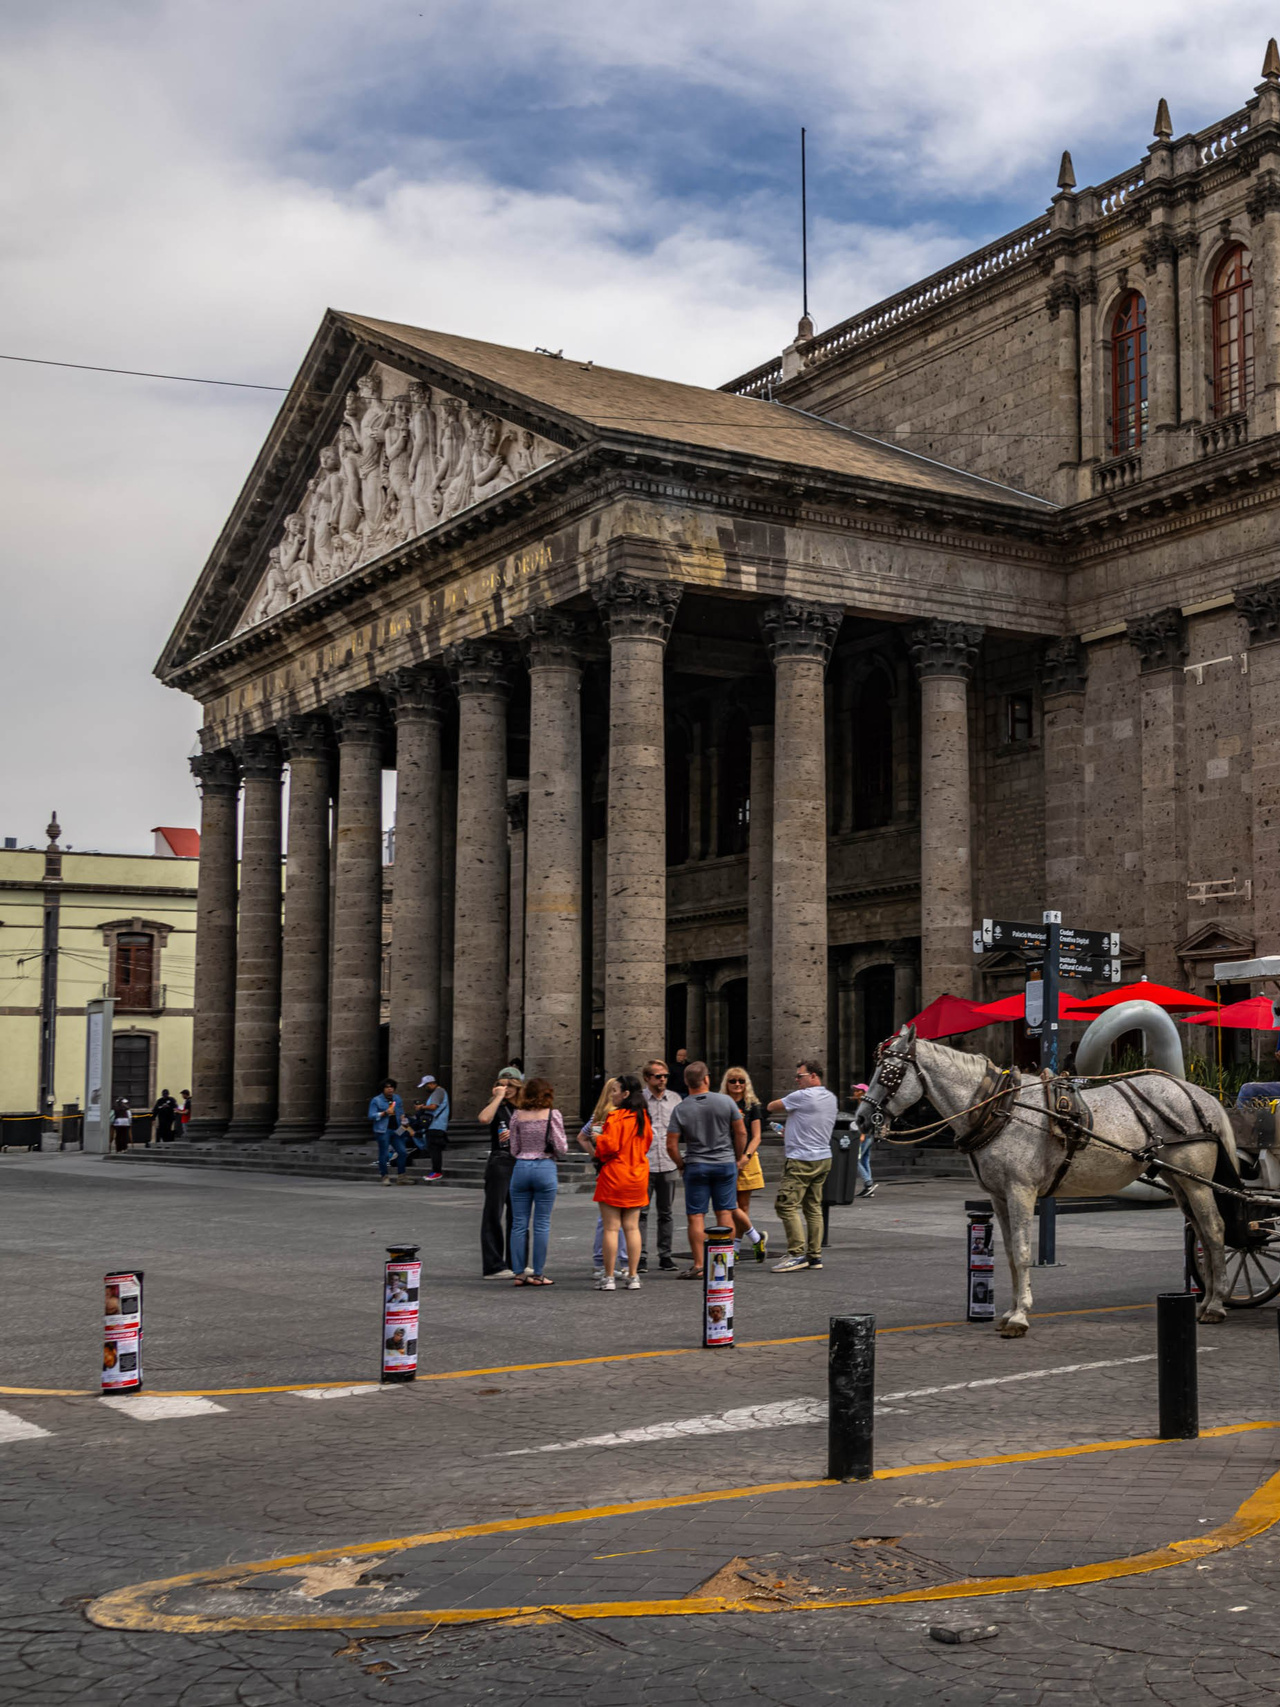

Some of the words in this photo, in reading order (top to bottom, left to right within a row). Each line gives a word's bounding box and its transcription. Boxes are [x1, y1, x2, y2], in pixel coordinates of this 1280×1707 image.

[1012, 930, 1028, 938] Palacio
[1028, 932, 1047, 940] Municipal
[1076, 937, 1090, 946] Digital
[1059, 956, 1077, 964] Instituto
[1059, 963, 1075, 971] Cultural
